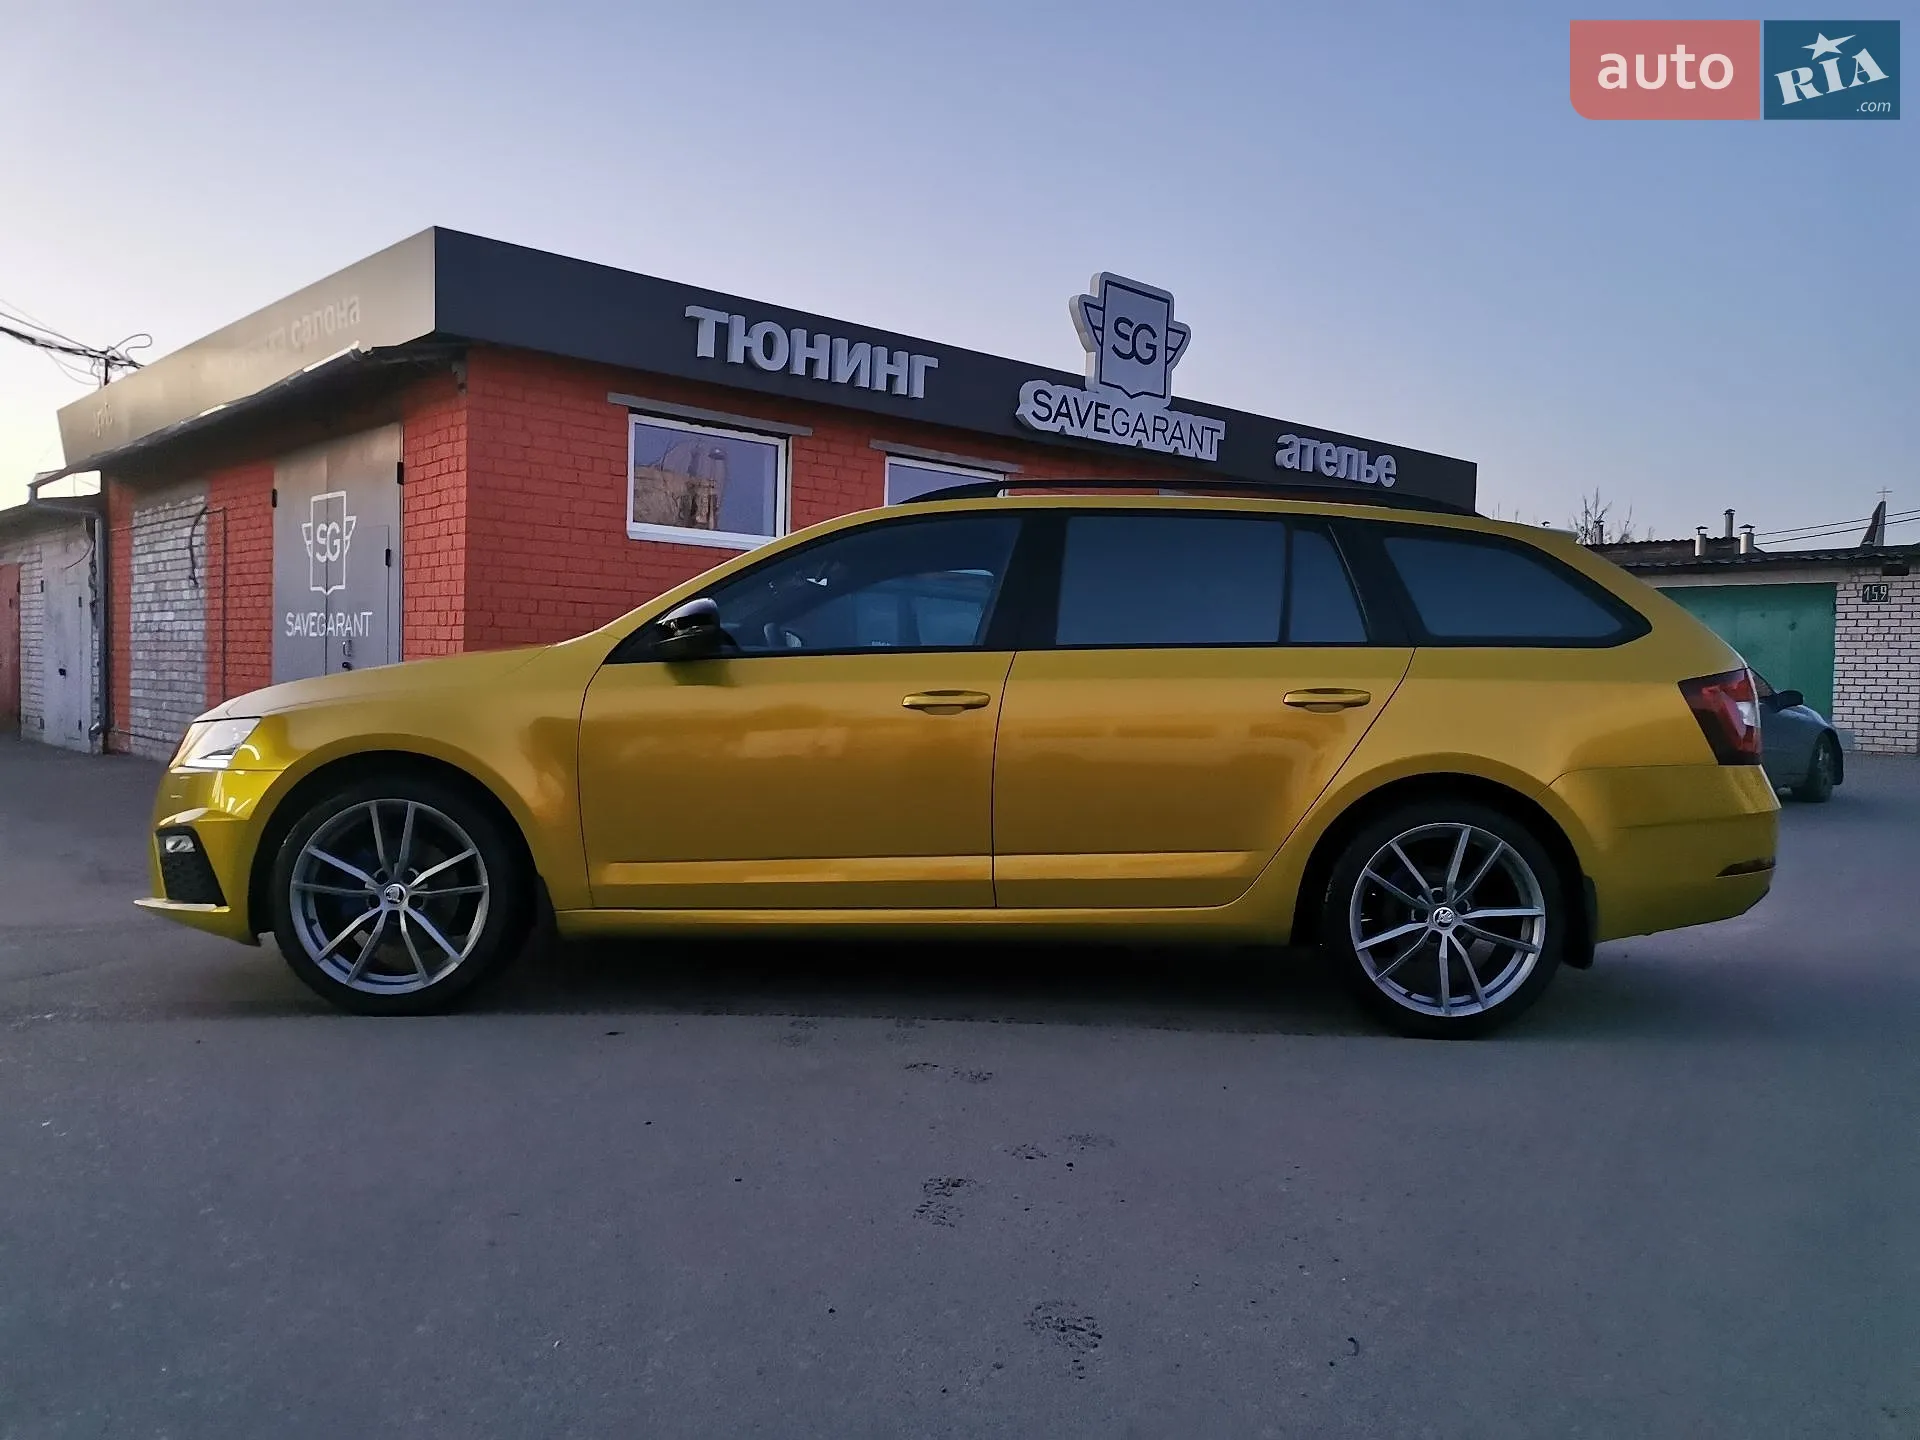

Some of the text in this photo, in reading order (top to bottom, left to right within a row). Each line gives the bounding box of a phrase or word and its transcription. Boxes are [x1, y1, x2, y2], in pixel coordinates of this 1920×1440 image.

[1112, 317, 1157, 365] SG
[1031, 388, 1220, 455] SAVEGARANT
[1275, 433, 1397, 488] ателье
[316, 521, 341, 563] SG
[1863, 585, 1887, 601] 159
[285, 611, 373, 637] SAVEGARANT
